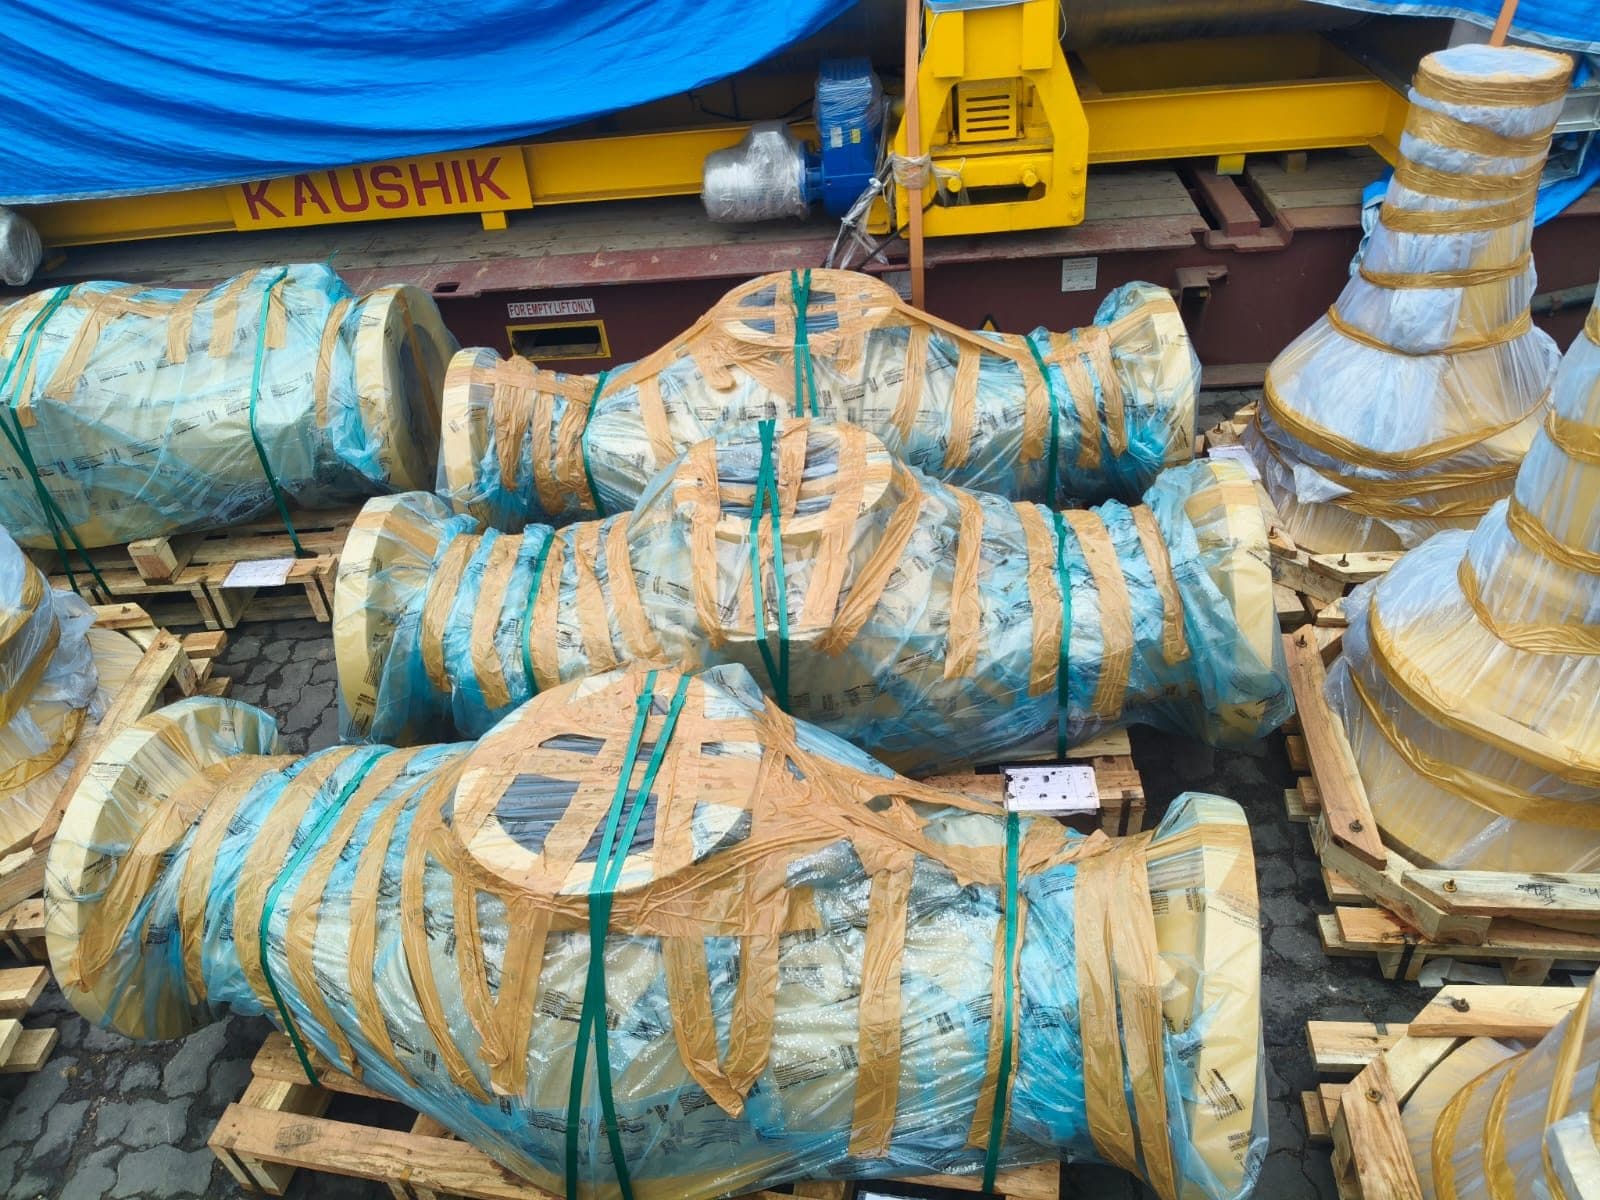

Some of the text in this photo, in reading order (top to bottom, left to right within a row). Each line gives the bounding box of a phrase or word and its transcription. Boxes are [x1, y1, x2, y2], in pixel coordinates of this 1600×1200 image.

[241, 157, 511, 220] KAUSHIK
[509, 300, 593, 316] FOR EMPTY LIFT ONLY
